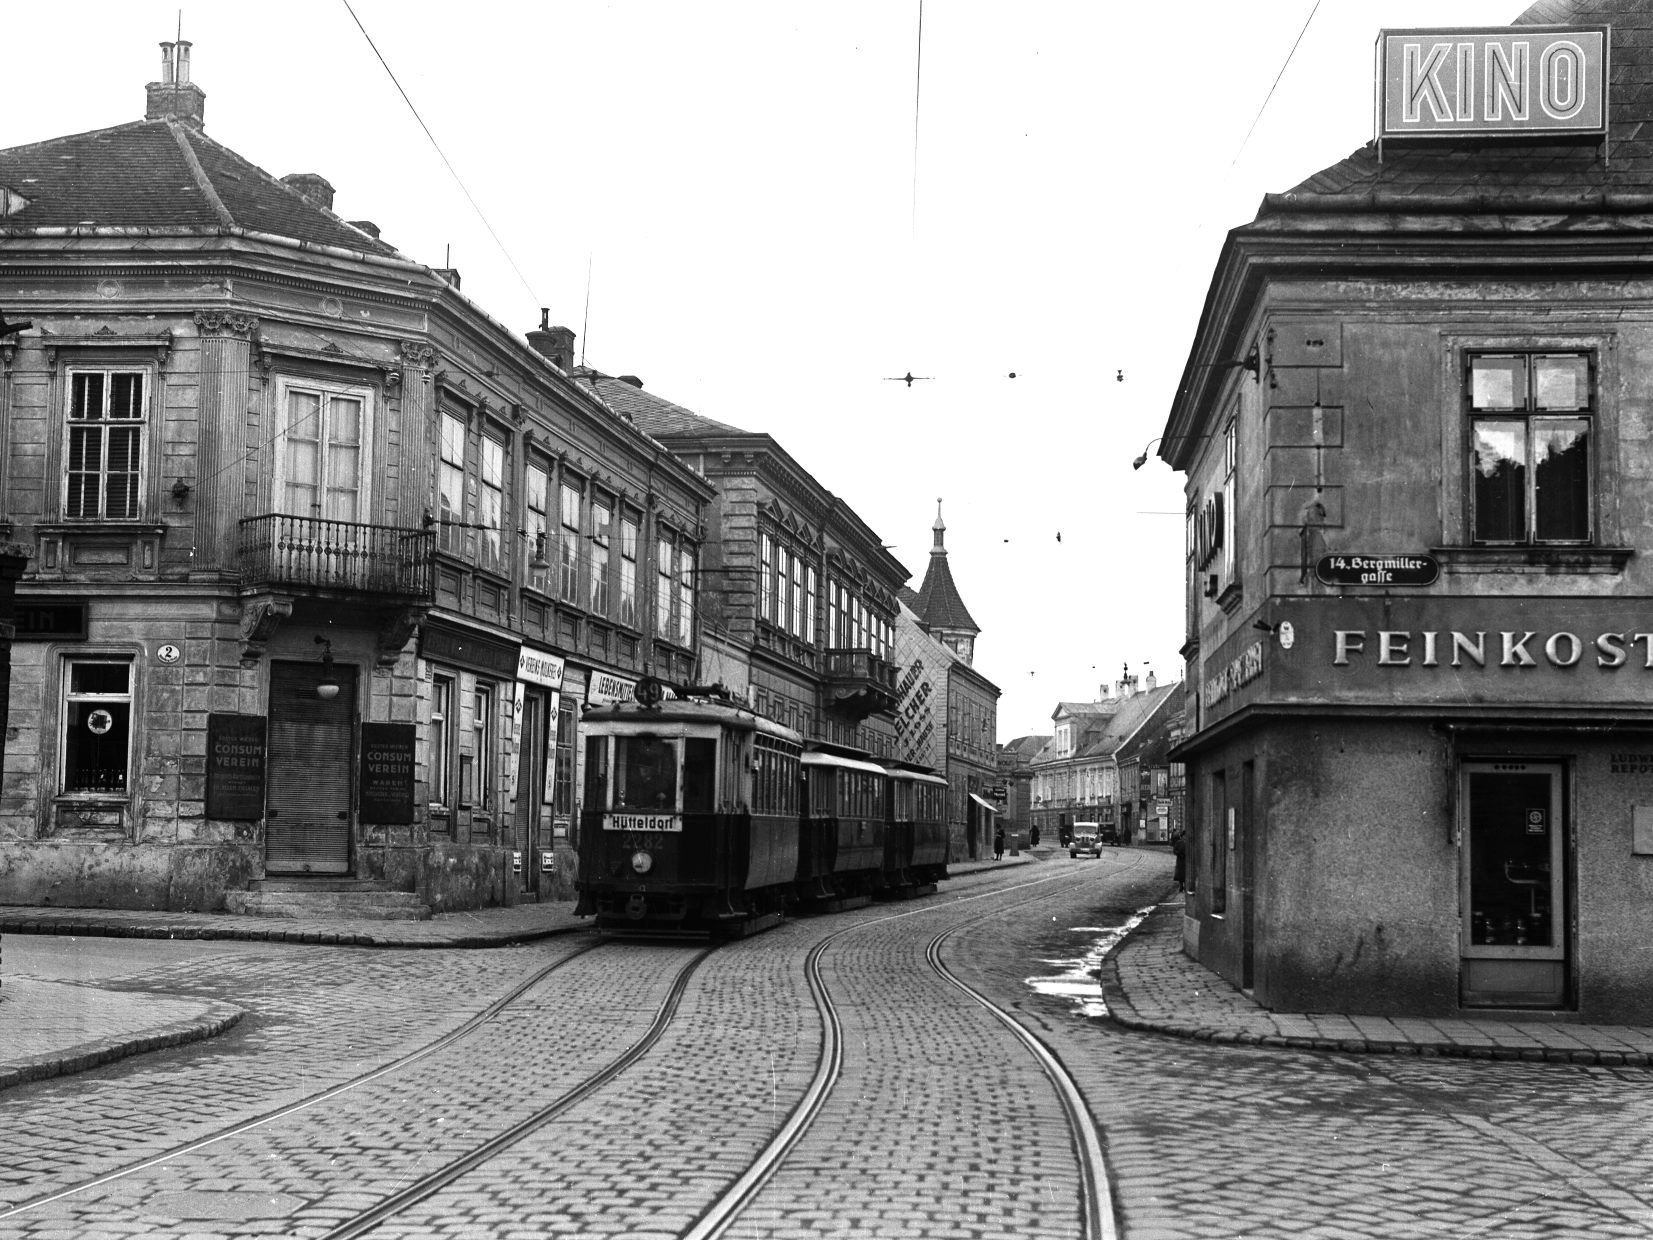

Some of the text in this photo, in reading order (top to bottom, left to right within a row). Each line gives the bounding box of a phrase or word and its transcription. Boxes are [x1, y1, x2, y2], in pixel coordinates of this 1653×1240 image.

[1403, 40, 1586, 122] KINO
[1352, 557, 1428, 572] Bergmiller-
[165, 646, 173, 658] 2
[1333, 630, 1653, 667] FEINKOST
[637, 683, 659, 701] 49
[215, 744, 262, 755] CONSUM
[215, 756, 260, 767] VEREIN
[367, 751, 412, 762] CONSUM
[368, 763, 409, 774] VEREIN
[612, 815, 673, 831] Hütteldorf
